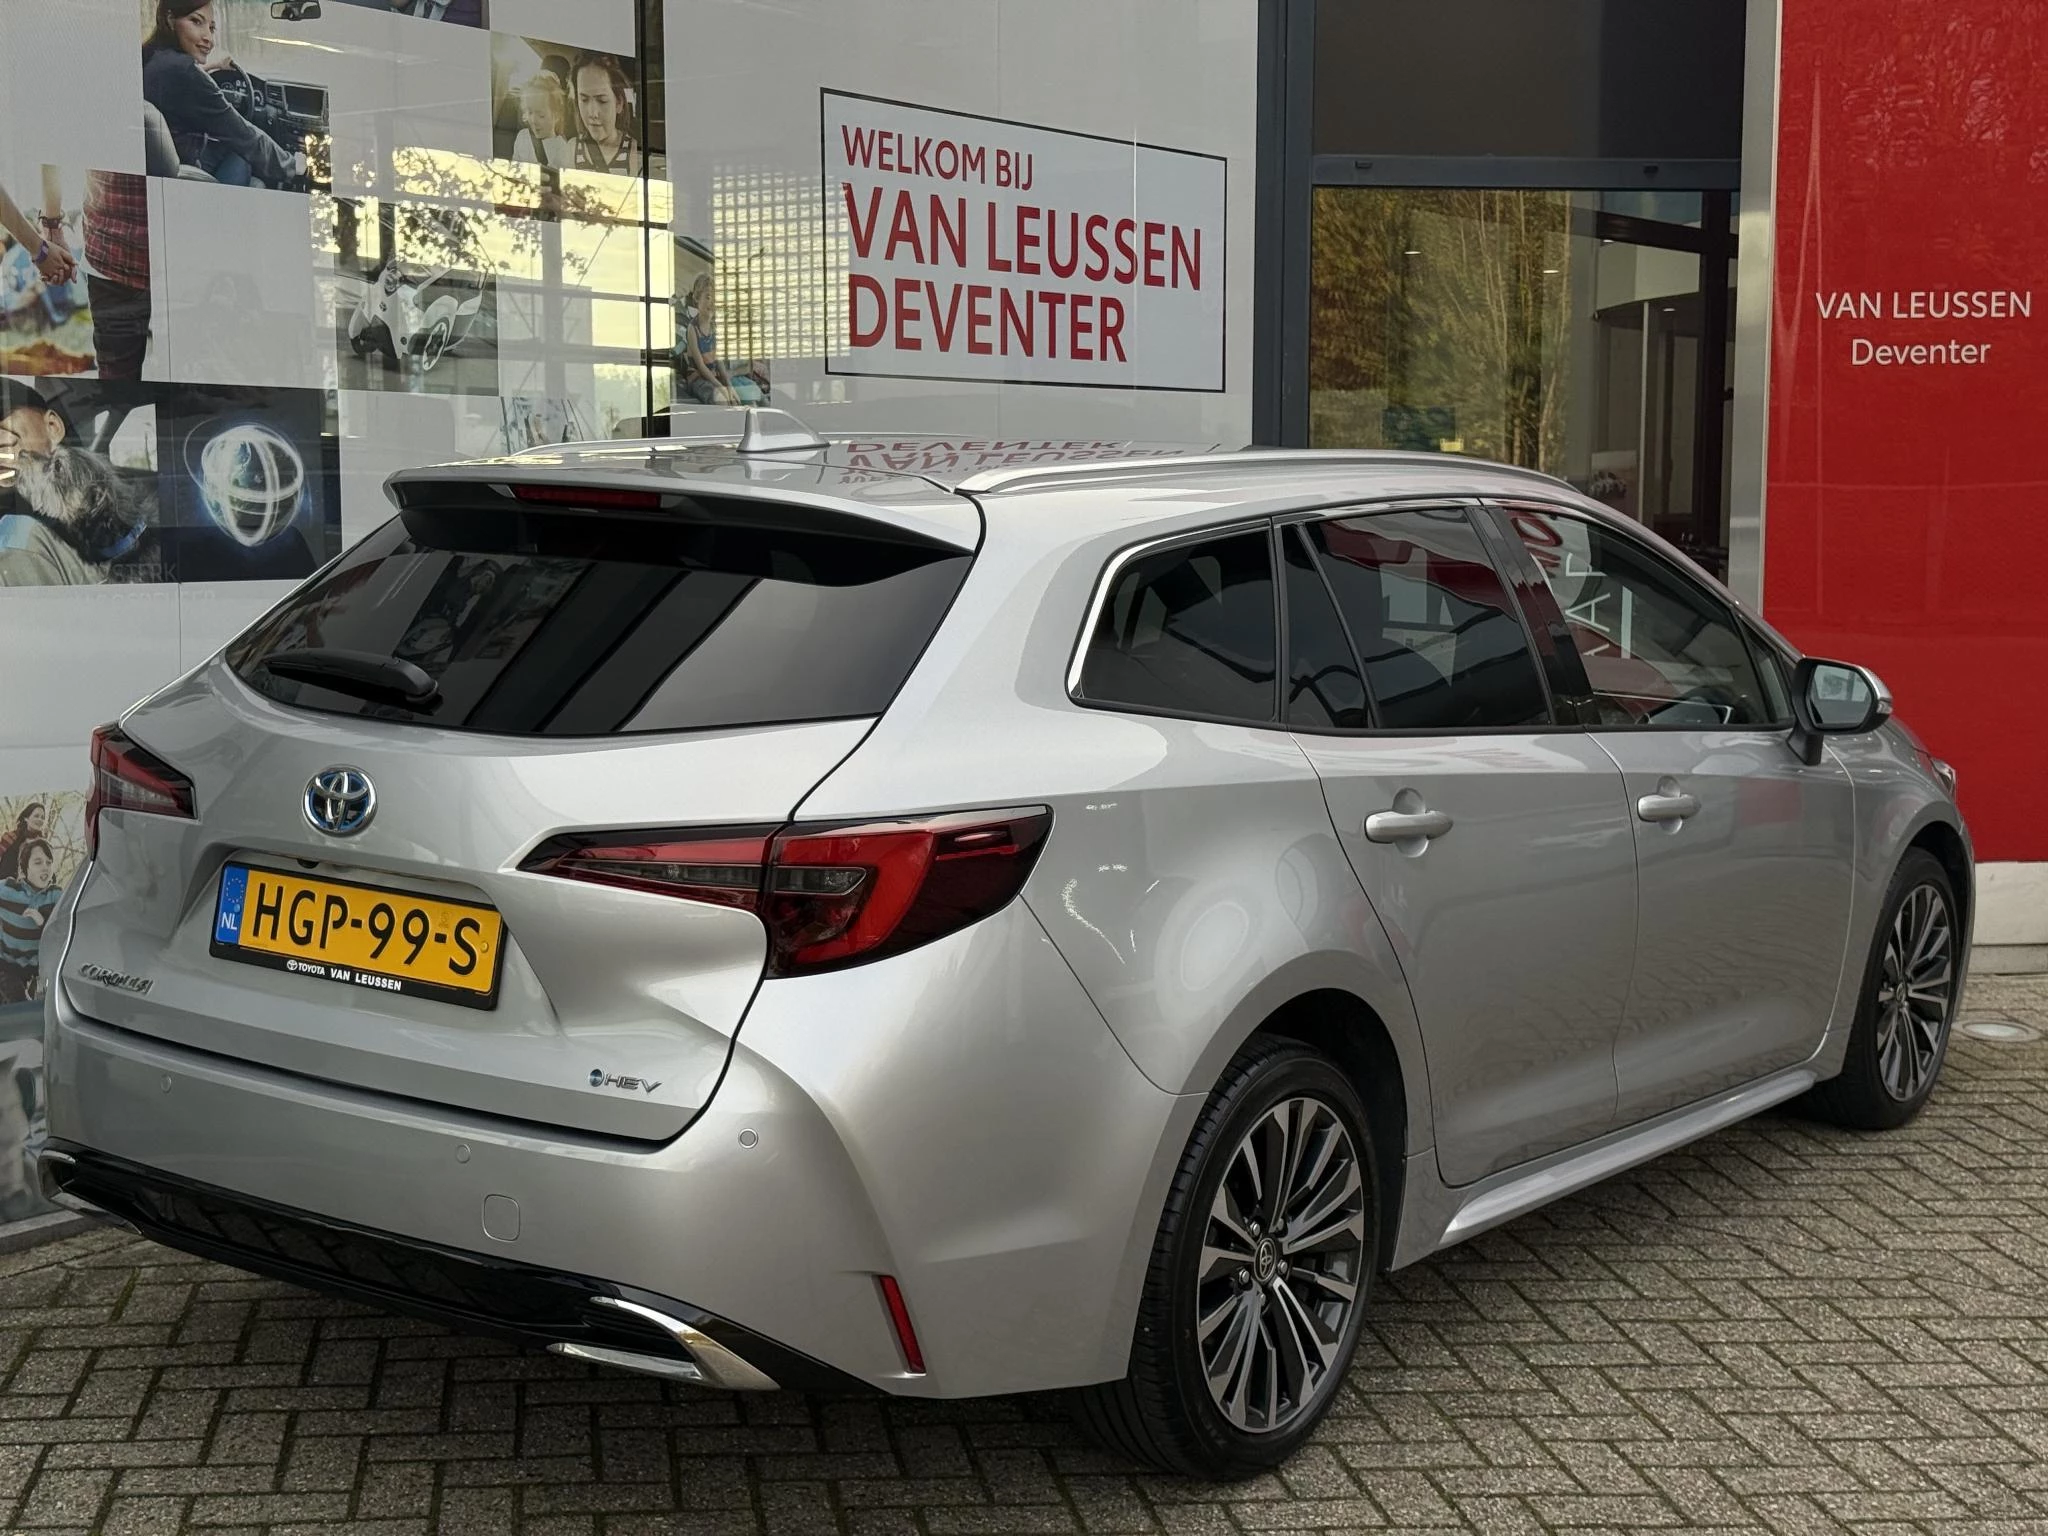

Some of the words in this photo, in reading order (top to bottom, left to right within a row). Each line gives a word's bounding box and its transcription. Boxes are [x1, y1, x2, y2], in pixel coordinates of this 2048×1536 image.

[841, 124, 987, 185] WELKOM
[995, 148, 1034, 191] BIJ
[842, 182, 967, 268] VAN
[987, 201, 1201, 291] LEUSSEN
[848, 273, 1128, 363] DEVENTER
[1815, 291, 1882, 319] VAN
[1892, 290, 2032, 319] LEUSSEN
[1851, 338, 1992, 366] Deventer
[220, 911, 238, 931] NL
[252, 882, 481, 976] HGP-99-S
[298, 962, 325, 976] TOYOTA
[330, 967, 351, 981] VAN
[355, 972, 402, 991] LEUSSEN
[604, 1073, 663, 1093] HEV
